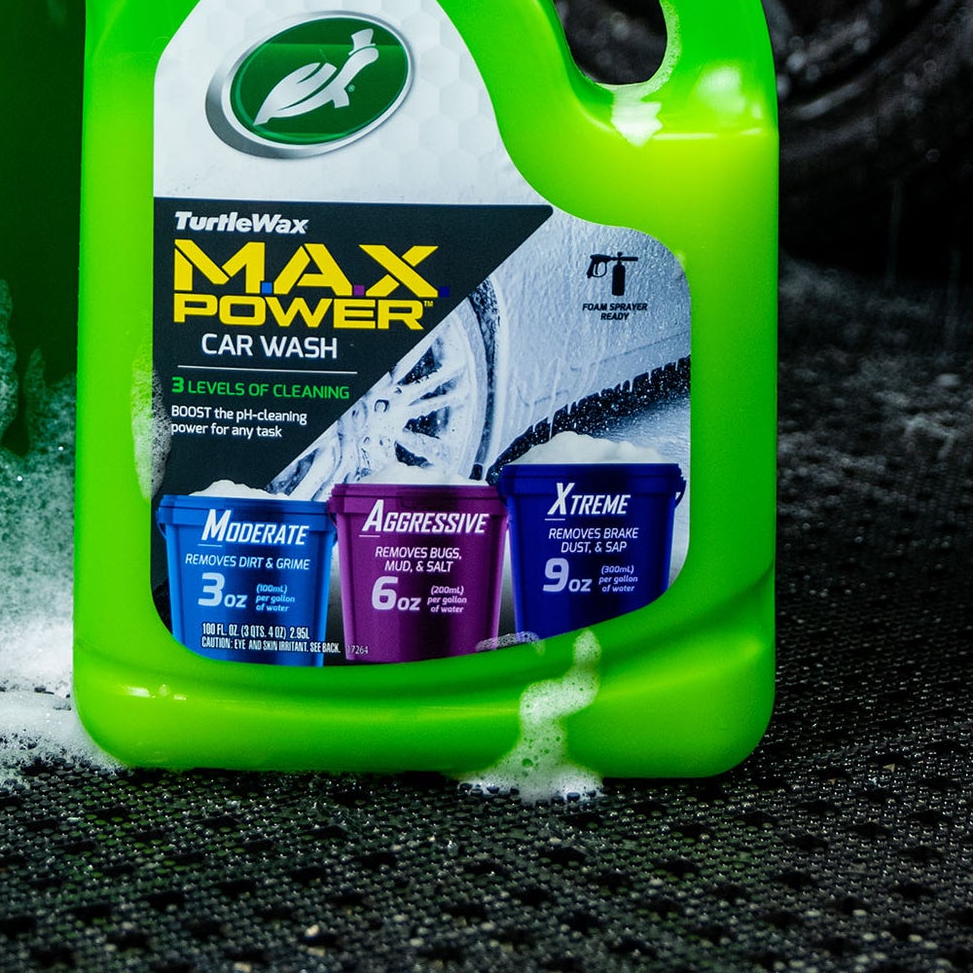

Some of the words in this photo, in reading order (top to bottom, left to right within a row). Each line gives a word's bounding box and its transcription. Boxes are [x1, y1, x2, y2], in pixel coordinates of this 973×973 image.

[582, 303, 607, 311] FOAM
[609, 303, 648, 311] SPRAYER
[600, 312, 630, 321] READY
[201, 332, 254, 357] CAR
[260, 335, 338, 359] WASH
[171, 376, 185, 393] 3
[188, 380, 245, 397] LEVELS
[248, 383, 270, 397] OF
[273, 384, 351, 400] CLEANING
[171, 404, 213, 419] BOOST
[214, 407, 234, 420] the
[236, 408, 308, 426] pH-cleaning
[170, 423, 209, 436] power
[210, 423, 229, 436] for
[231, 427, 255, 440] any
[256, 425, 283, 438] task
[548, 527, 602, 540] REMOVES
[603, 527, 640, 540] BRAKE
[374, 546, 428, 560] REMOVES
[429, 547, 463, 560] BUGS,
[560, 541, 592, 554] DUST,
[594, 541, 603, 553] &
[605, 541, 628, 553] SAP
[185, 553, 237, 567] REMOVES
[238, 556, 264, 568] DIRT
[265, 557, 274, 569] &
[276, 557, 311, 571] GRIME
[384, 560, 414, 573] MUD,
[415, 561, 424, 573] &
[426, 560, 454, 573] SALT
[598, 576, 613, 585] per
[601, 585, 611, 593] of
[612, 585, 636, 593] water
[255, 595, 270, 604] per
[427, 597, 441, 606] per
[255, 603, 266, 612] of
[430, 605, 440, 613] of
[440, 605, 464, 613] water
[202, 622, 216, 635] 100
[268, 626, 274, 637] 4
[289, 627, 310, 639] 2.95L
[201, 636, 233, 649] CAUTION:
[234, 639, 246, 650] EYE
[248, 639, 262, 650] AND
[262, 640, 278, 651] SKIN
[309, 642, 322, 653] SEE
[322, 642, 341, 654] BACK.
